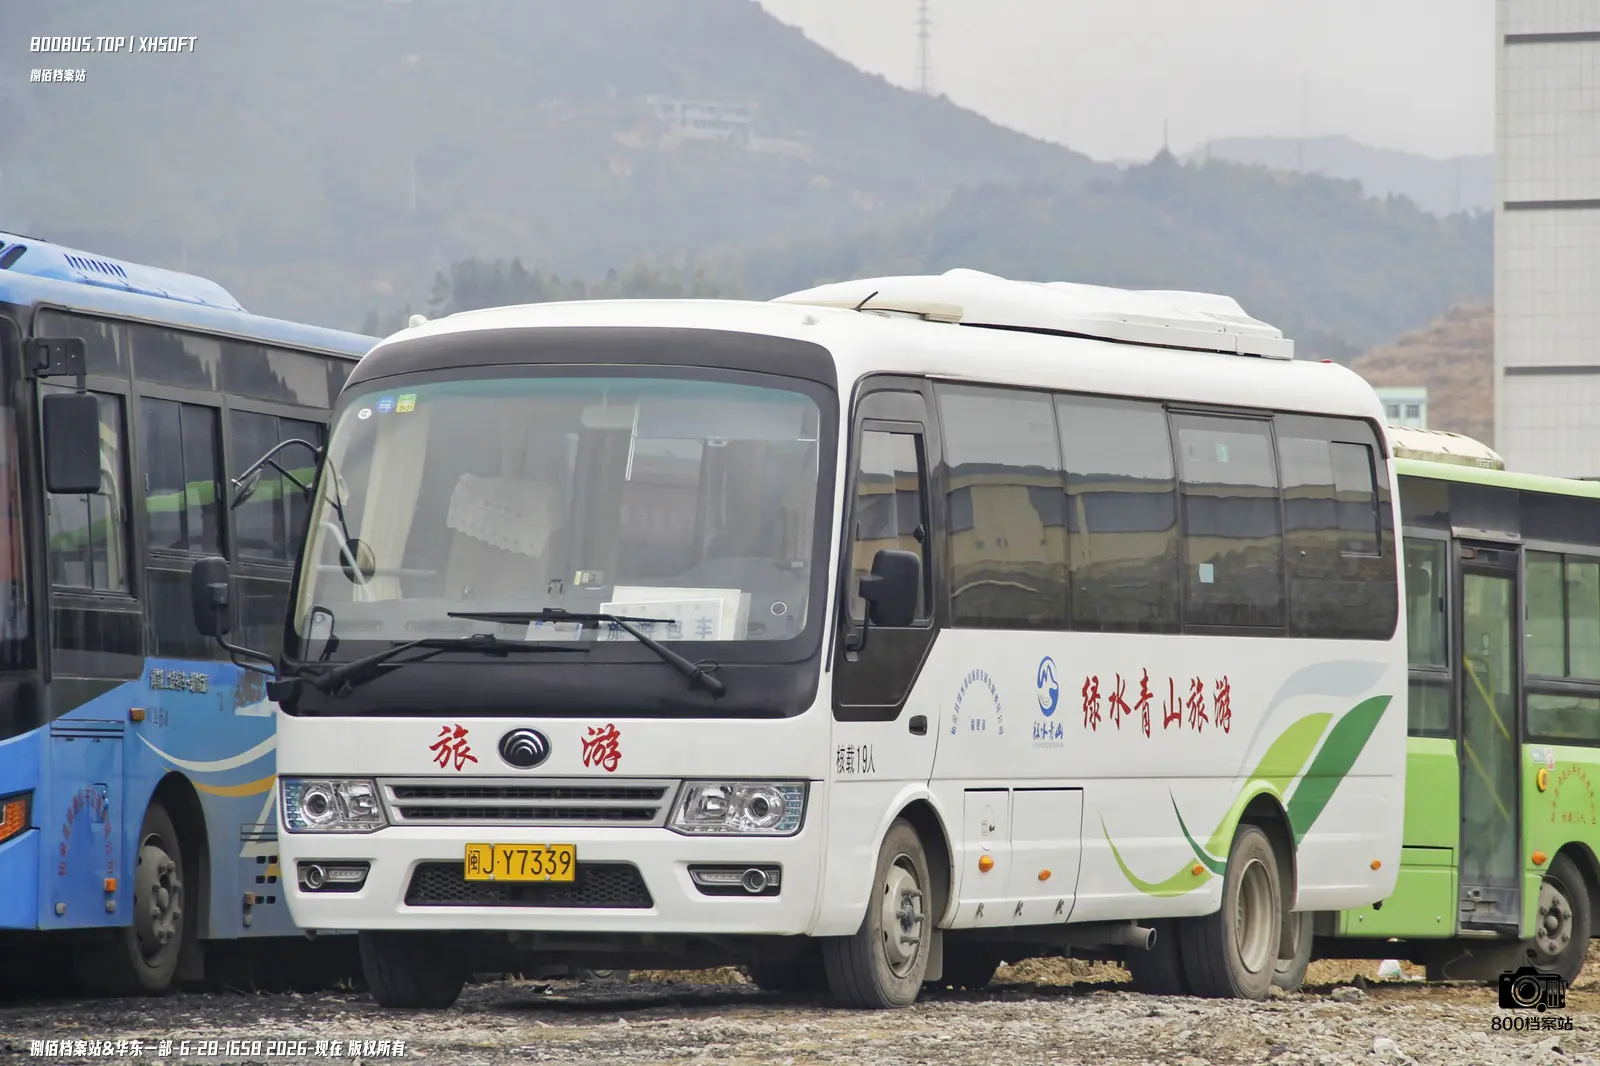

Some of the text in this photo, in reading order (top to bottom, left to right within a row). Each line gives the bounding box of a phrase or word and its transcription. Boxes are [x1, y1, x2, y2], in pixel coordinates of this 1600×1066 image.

[1082, 667, 1232, 739] 绿水青山旅游
[429, 723, 622, 772] 旅 游
[836, 744, 876, 774] 核载19人
